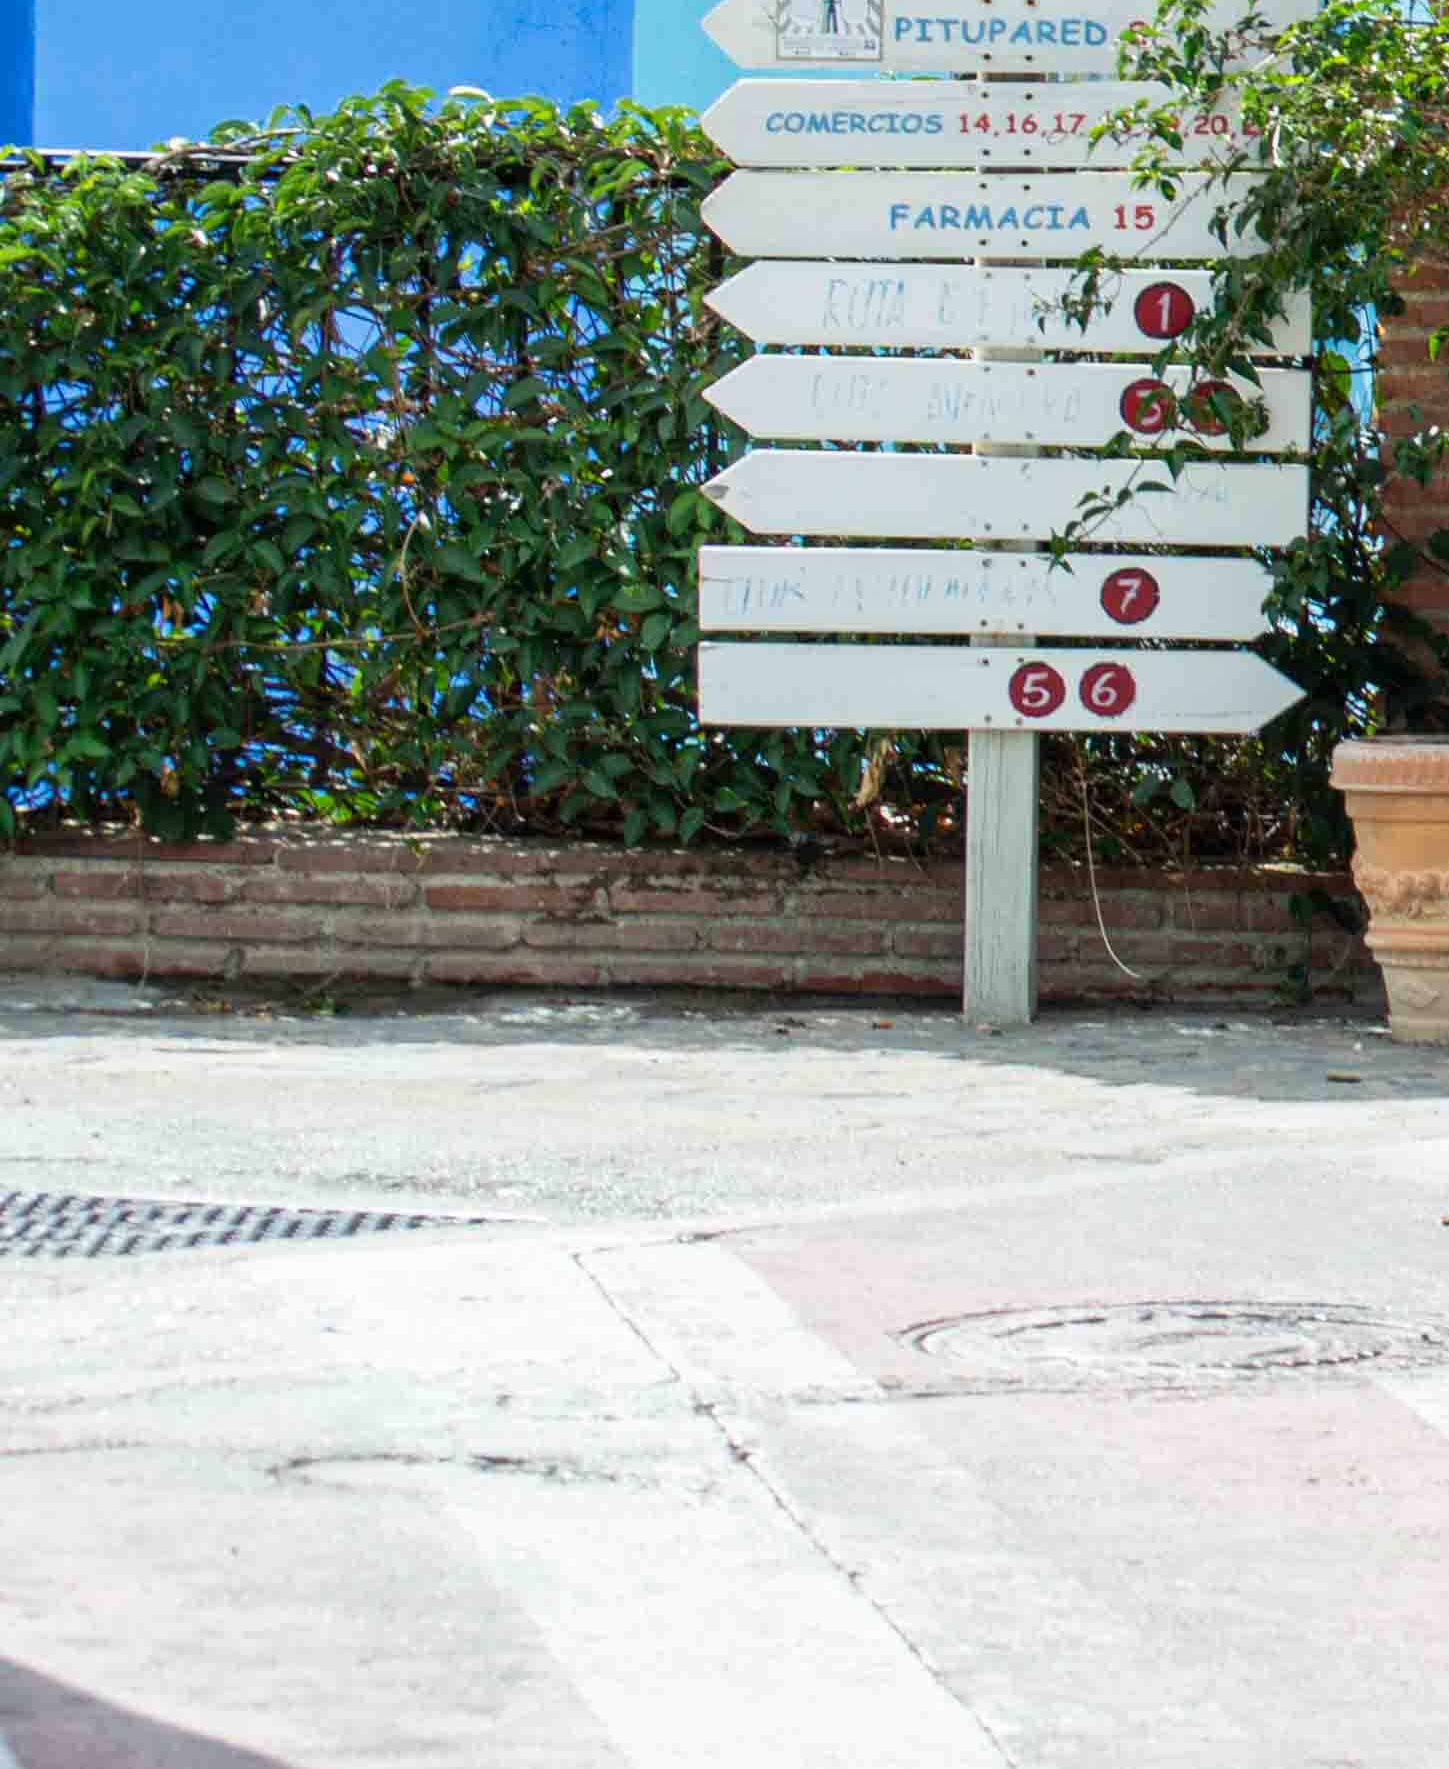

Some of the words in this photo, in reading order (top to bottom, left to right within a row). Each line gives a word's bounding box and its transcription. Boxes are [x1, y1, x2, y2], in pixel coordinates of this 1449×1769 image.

[894, 17, 1108, 46] PITUPARED
[766, 111, 944, 135] COMERCIOS
[890, 204, 1091, 230] FARMACIA
[1113, 204, 1155, 230] 15
[1116, 577, 1143, 615] 7
[1021, 670, 1051, 709] 5
[1091, 669, 1118, 708] 6
